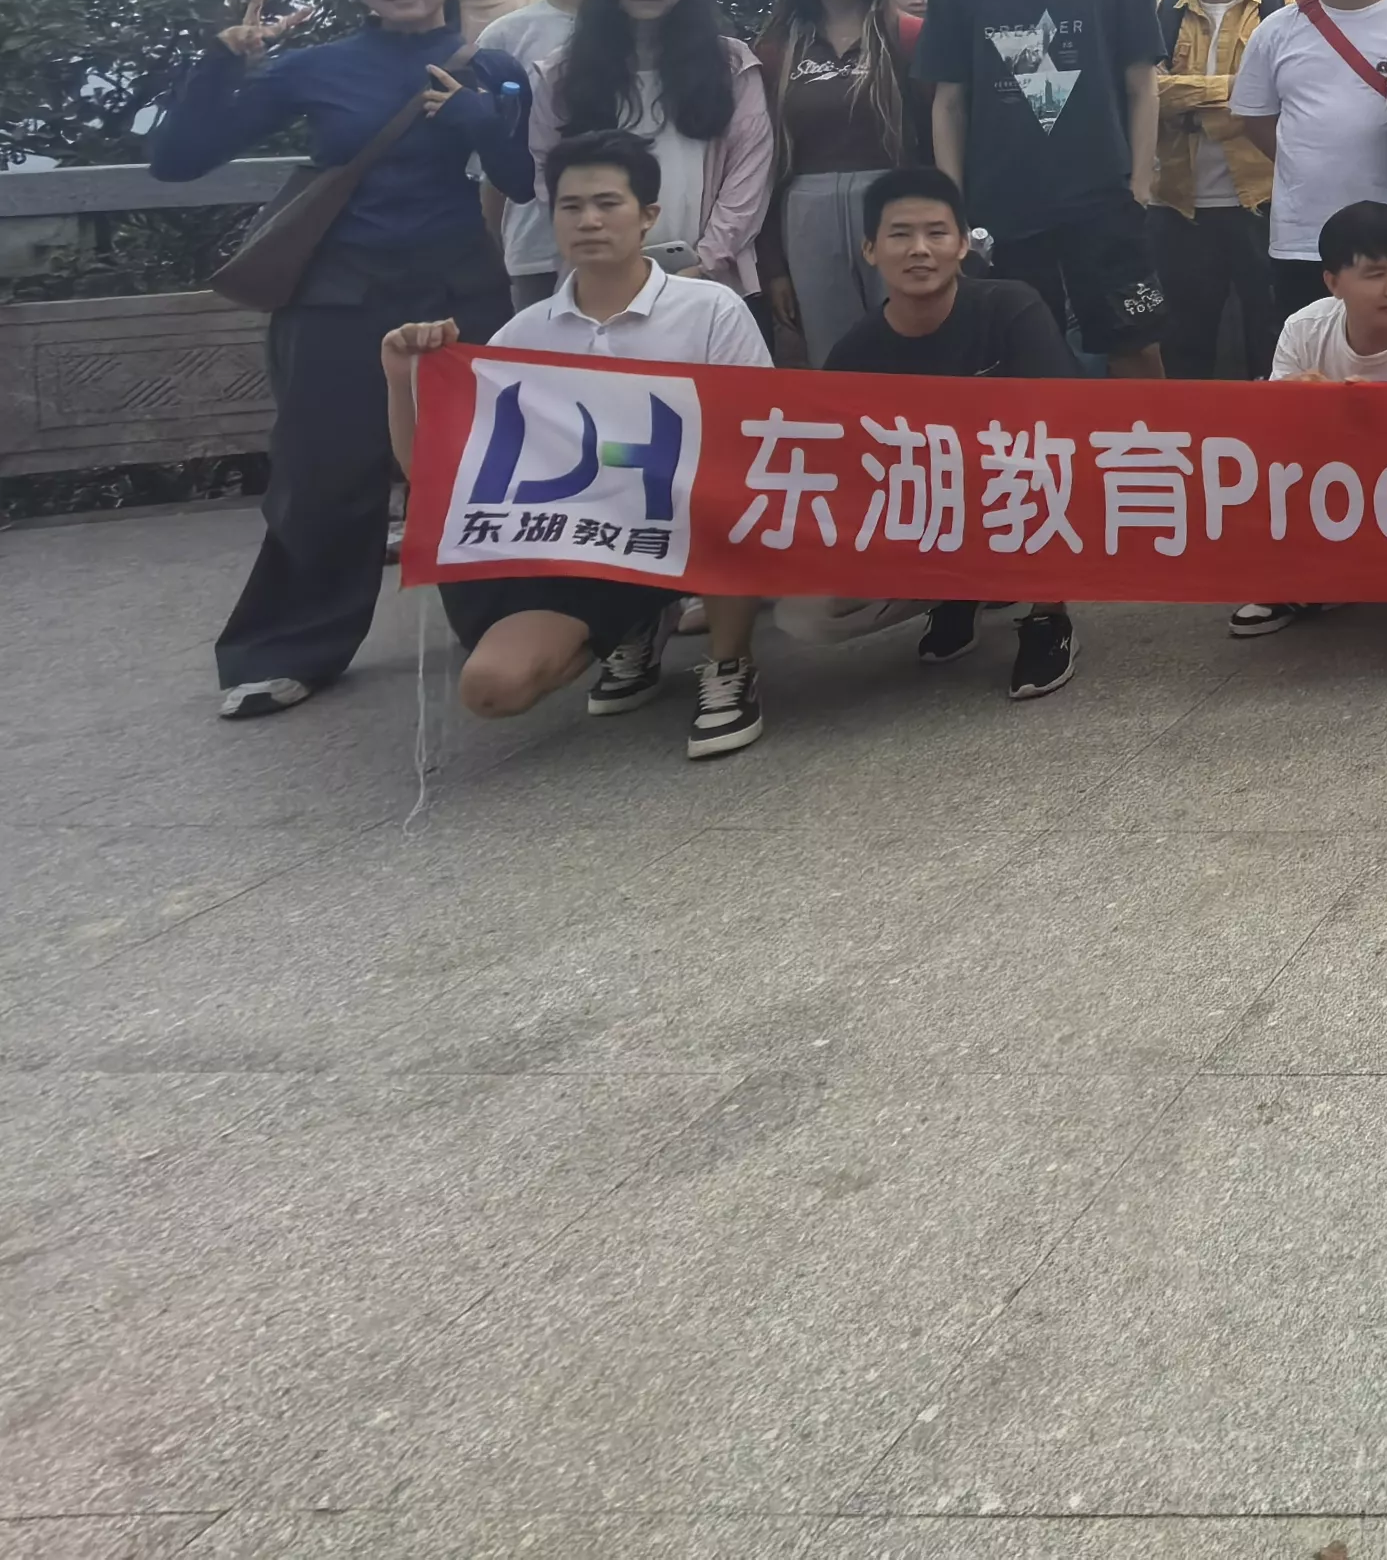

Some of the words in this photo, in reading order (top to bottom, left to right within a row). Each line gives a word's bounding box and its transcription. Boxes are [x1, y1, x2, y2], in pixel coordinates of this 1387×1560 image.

[985, 21, 1082, 39] DREAER
[457, 510, 674, 560] 东湖教育
